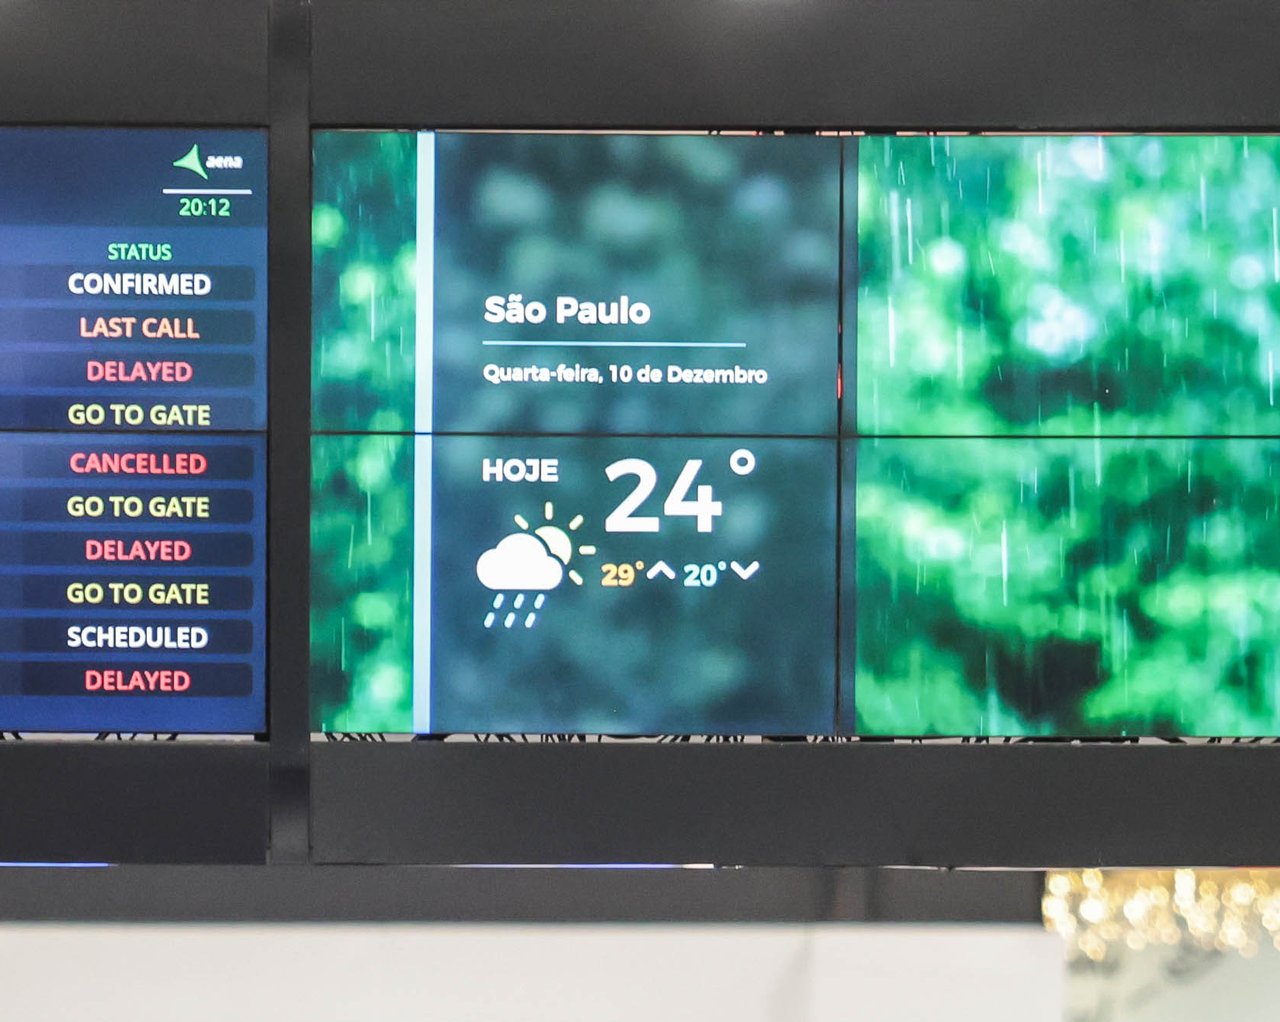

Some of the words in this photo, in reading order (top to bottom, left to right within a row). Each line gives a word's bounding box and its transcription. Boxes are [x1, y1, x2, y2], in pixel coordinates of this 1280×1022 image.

[205, 155, 244, 169] aena
[178, 197, 231, 217] 20:12
[107, 242, 173, 261] STATUS
[67, 272, 212, 296] CONFIRMED
[483, 293, 547, 324] São
[556, 295, 651, 325] Paulo
[79, 316, 137, 338] LAST
[141, 317, 201, 339] CALL
[86, 360, 193, 383] DELAYED
[483, 364, 604, 384] Quarta-feira,
[608, 365, 633, 383] 10
[636, 365, 663, 383] de
[667, 365, 768, 384] Dezembro
[69, 452, 208, 475] CANCELLED
[482, 458, 560, 483] HOJE
[85, 539, 192, 561] DELAYED
[67, 625, 209, 649] SCHEDULED
